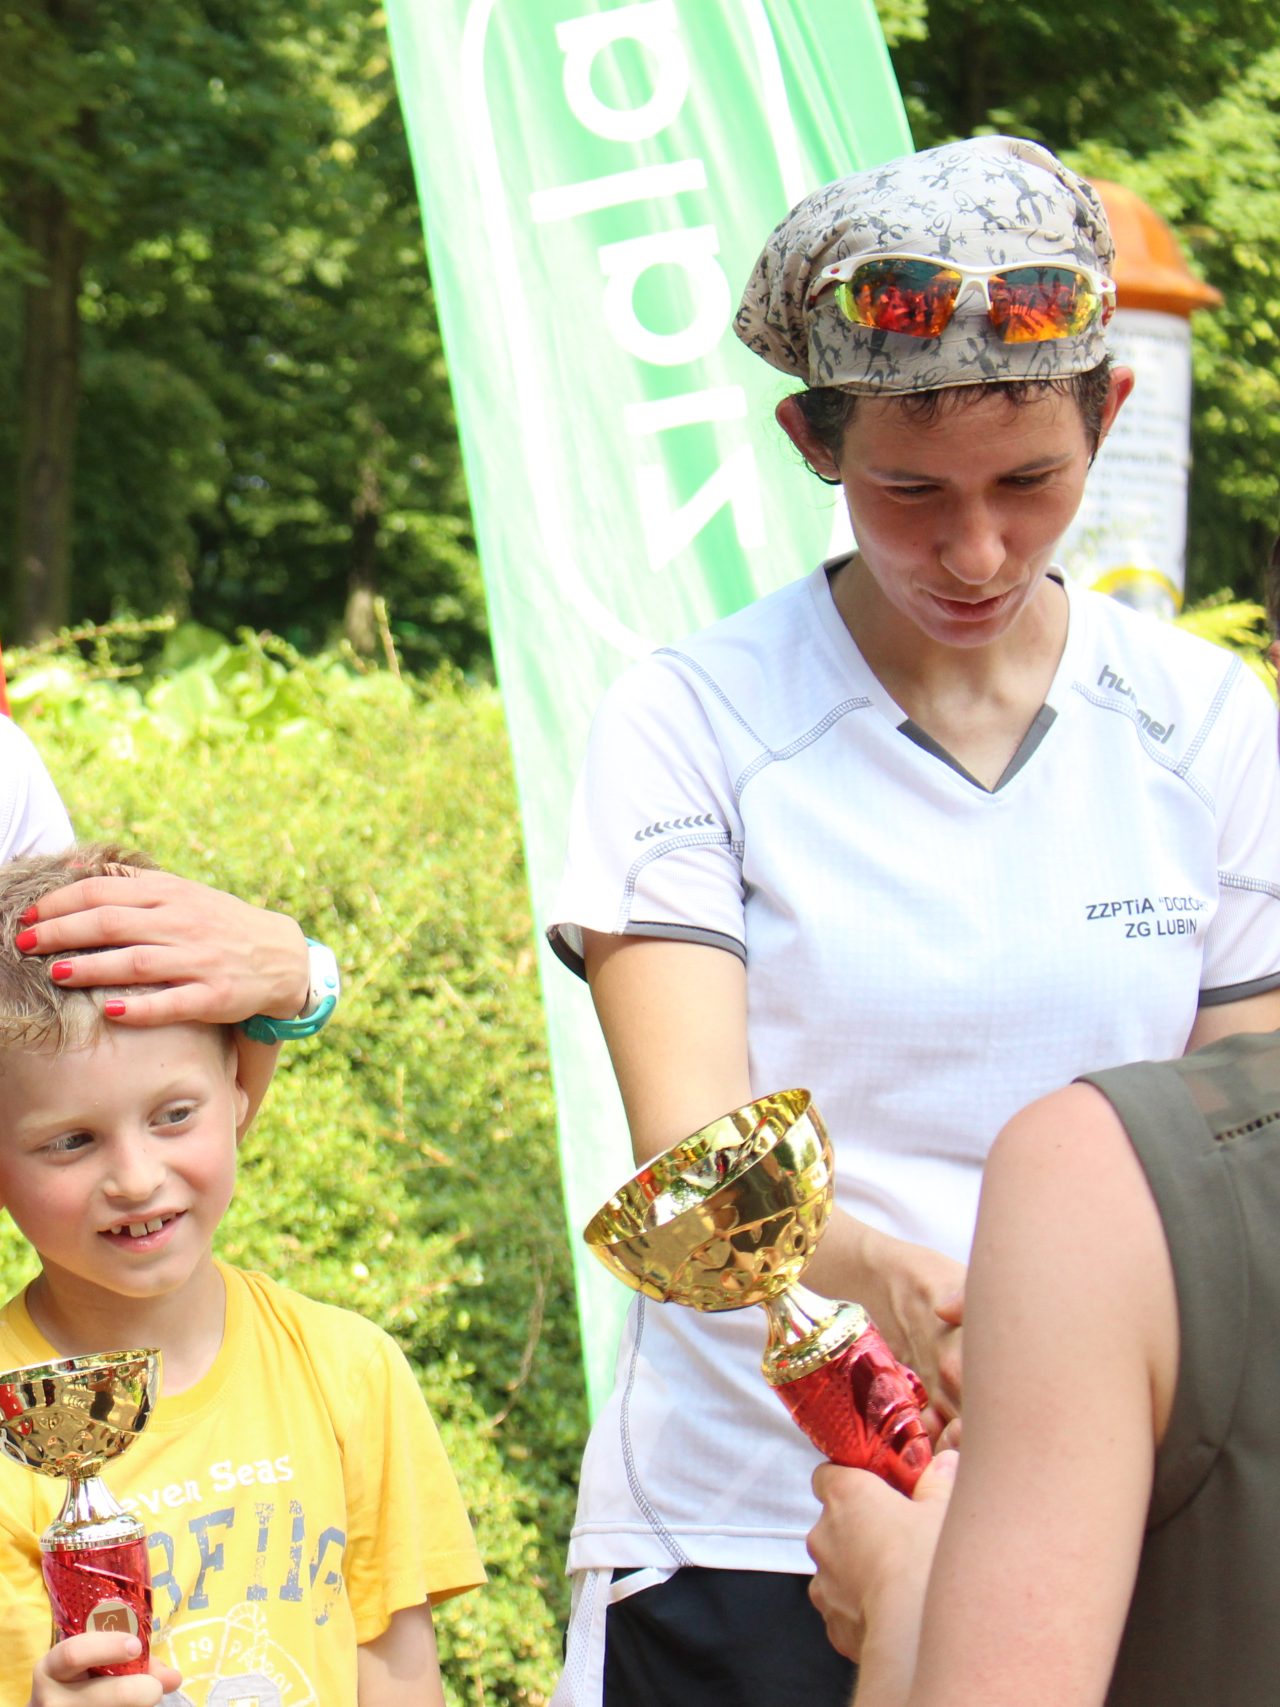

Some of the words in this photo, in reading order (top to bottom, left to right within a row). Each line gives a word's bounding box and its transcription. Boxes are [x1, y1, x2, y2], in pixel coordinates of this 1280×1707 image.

[1097, 664, 1175, 744] humel
[1085, 898, 1155, 920] ZZPTiA
[1125, 921, 1151, 938] ZG
[1157, 918, 1197, 936] LUBIN
[209, 1455, 294, 1493] Seas
